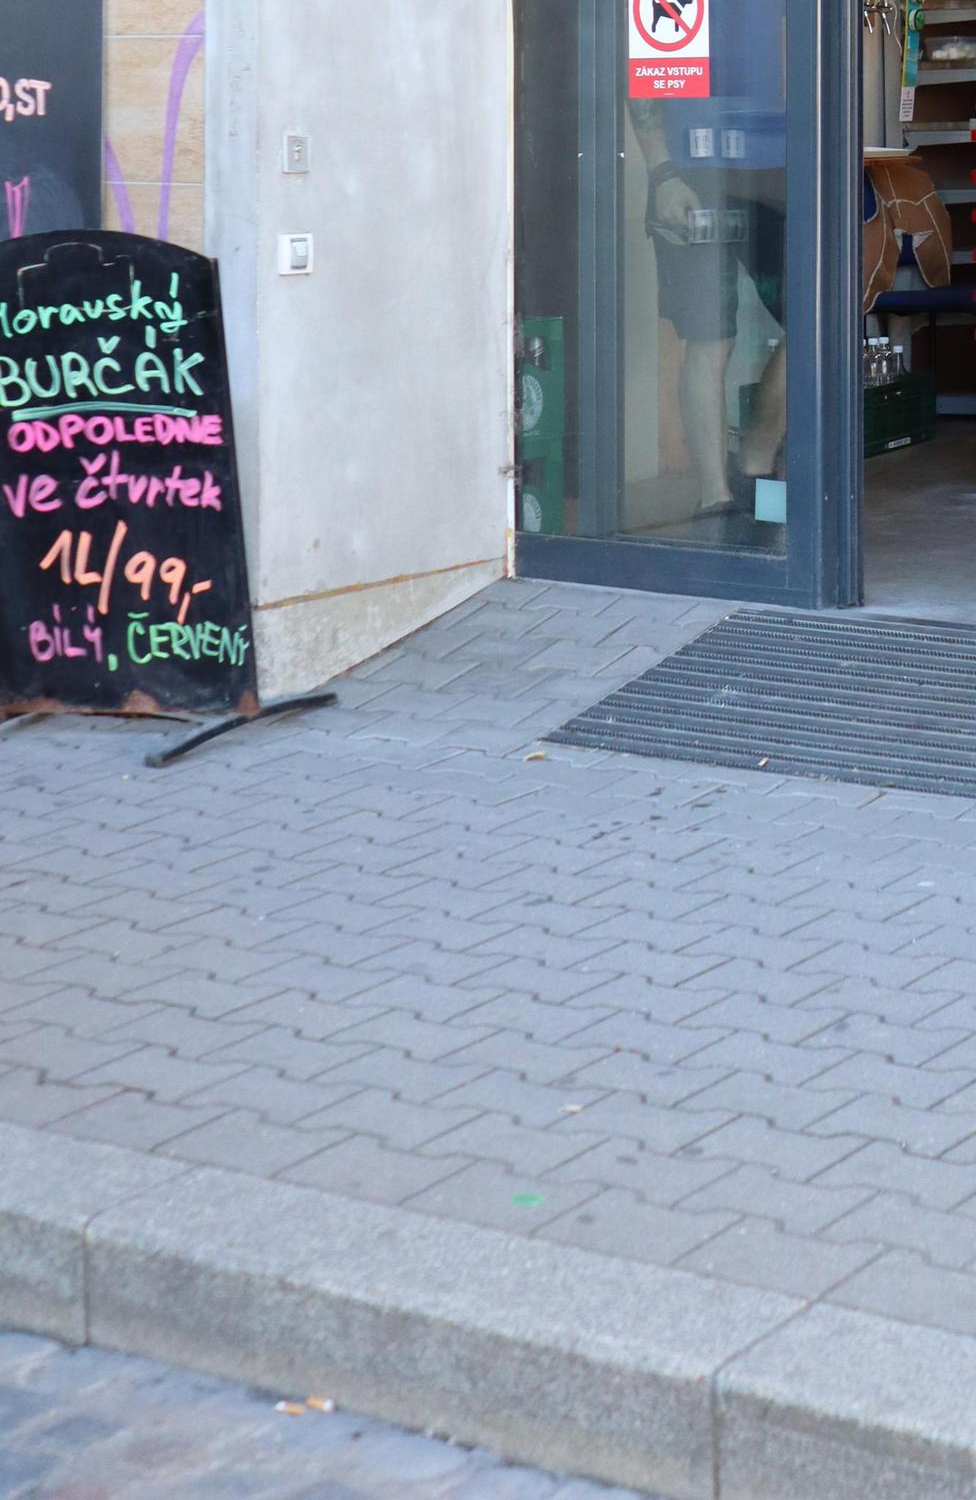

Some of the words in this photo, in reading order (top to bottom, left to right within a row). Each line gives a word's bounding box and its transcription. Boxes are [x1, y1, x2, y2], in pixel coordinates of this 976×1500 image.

[635, 65, 666, 77] ZÁKAZ
[666, 66, 703, 77] VSTUPU
[653, 79, 666, 89] SE
[667, 79, 686, 89] PSY
[0, 325, 205, 407] BURČÁK
[7, 414, 223, 453] ODPOLEDNE
[2, 474, 63, 518] ve
[75, 450, 223, 512] čtvrtek
